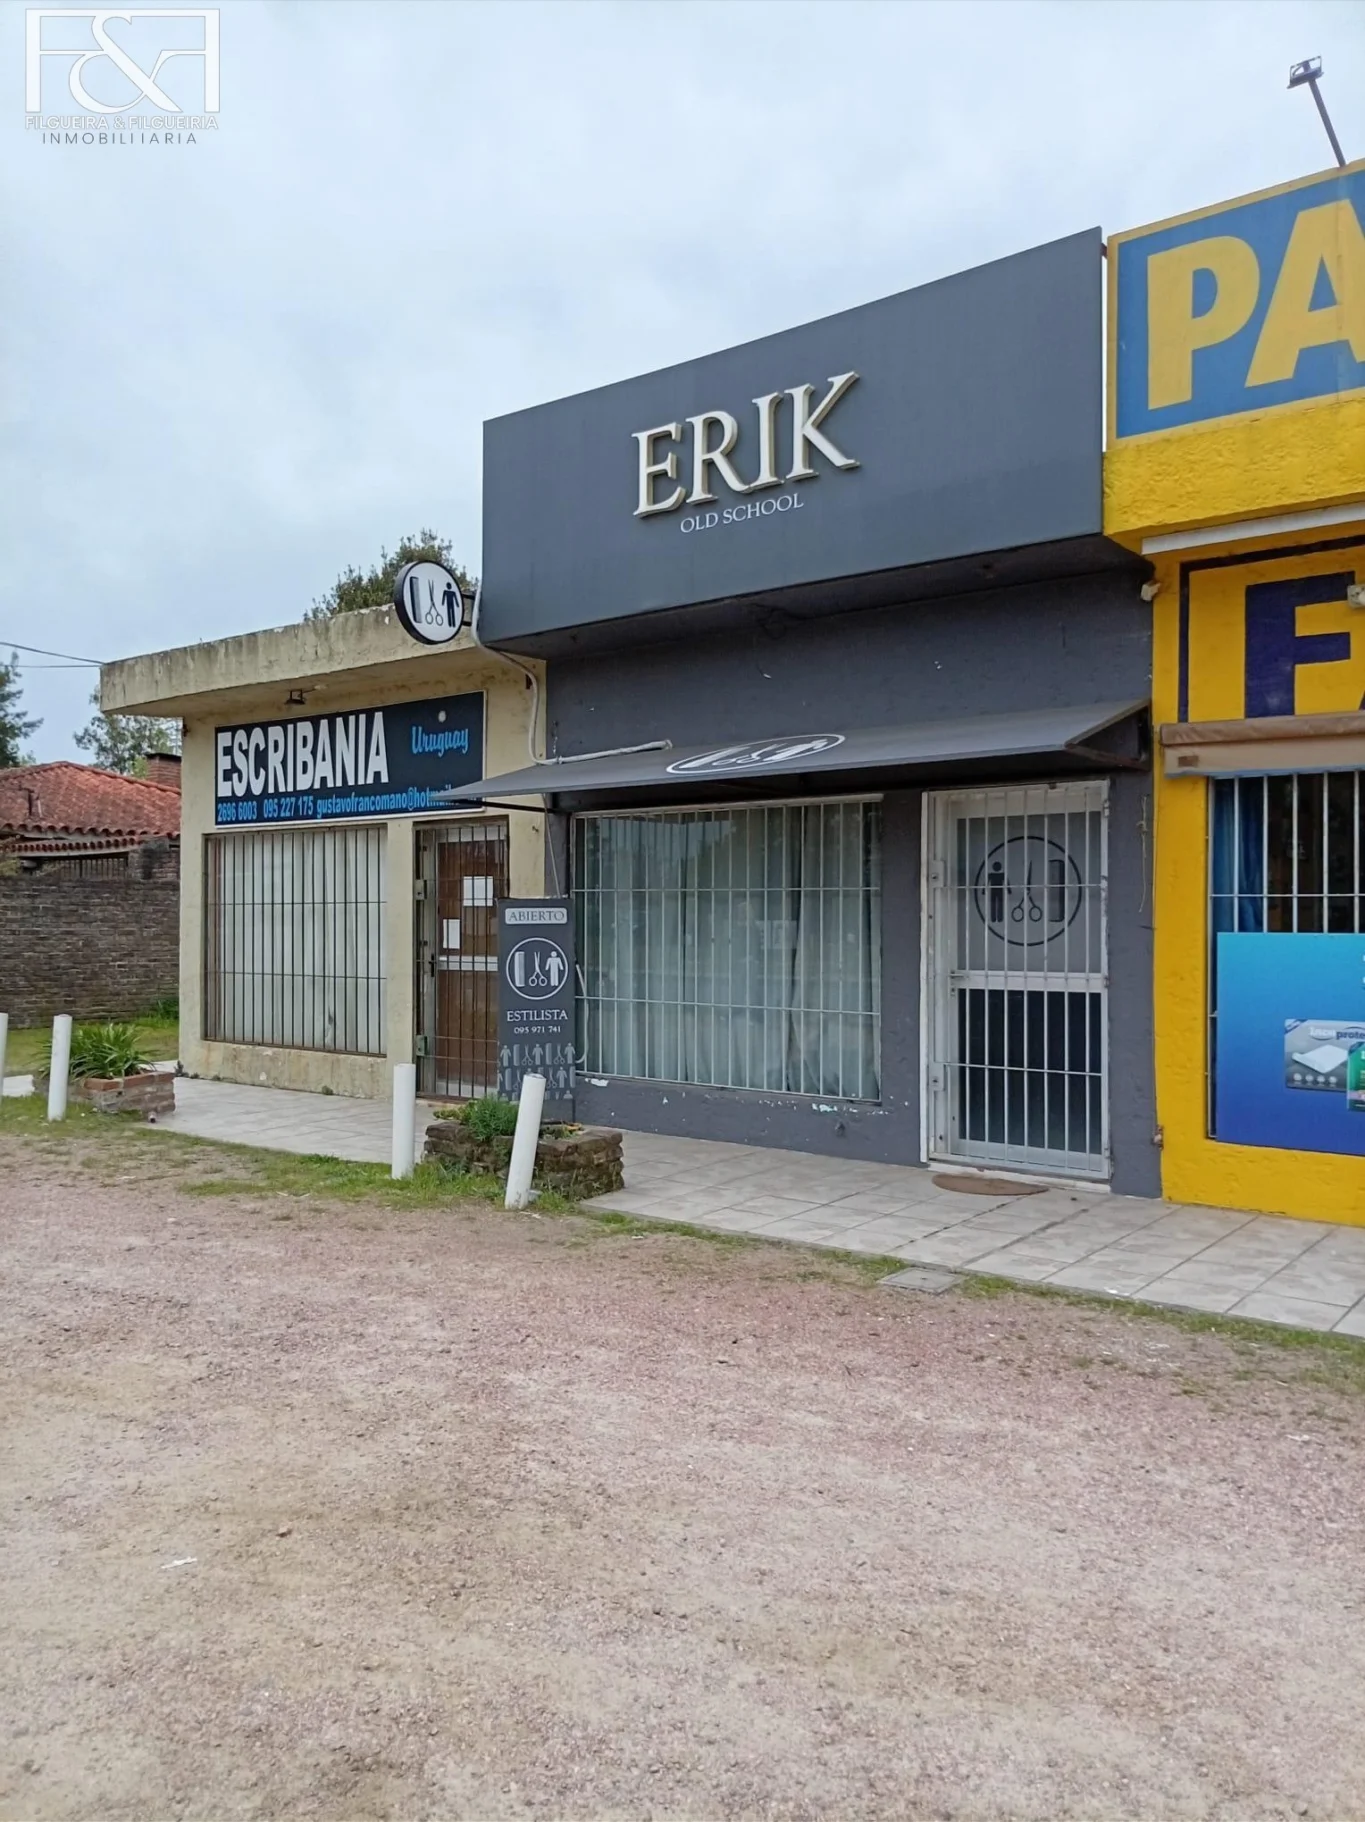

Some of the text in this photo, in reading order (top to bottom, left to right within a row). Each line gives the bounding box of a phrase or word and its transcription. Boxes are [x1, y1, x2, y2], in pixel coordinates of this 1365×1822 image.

[631, 371, 861, 519] ERIK
[680, 493, 804, 533] OLD SCHOOL
[1244, 570, 1365, 719] F
[217, 711, 389, 798] ESCRIBANIA
[411, 725, 469, 758] Uruguay
[217, 803, 237, 822] 2696
[238, 801, 257, 821] 6003
[263, 798, 279, 819] 095
[280, 797, 296, 818] 227
[298, 796, 314, 816] 175
[508, 910, 565, 922] ABIERTO
[506, 1009, 568, 1022] ESTILISTA
[513, 1025, 561, 1034] 095 971 741
